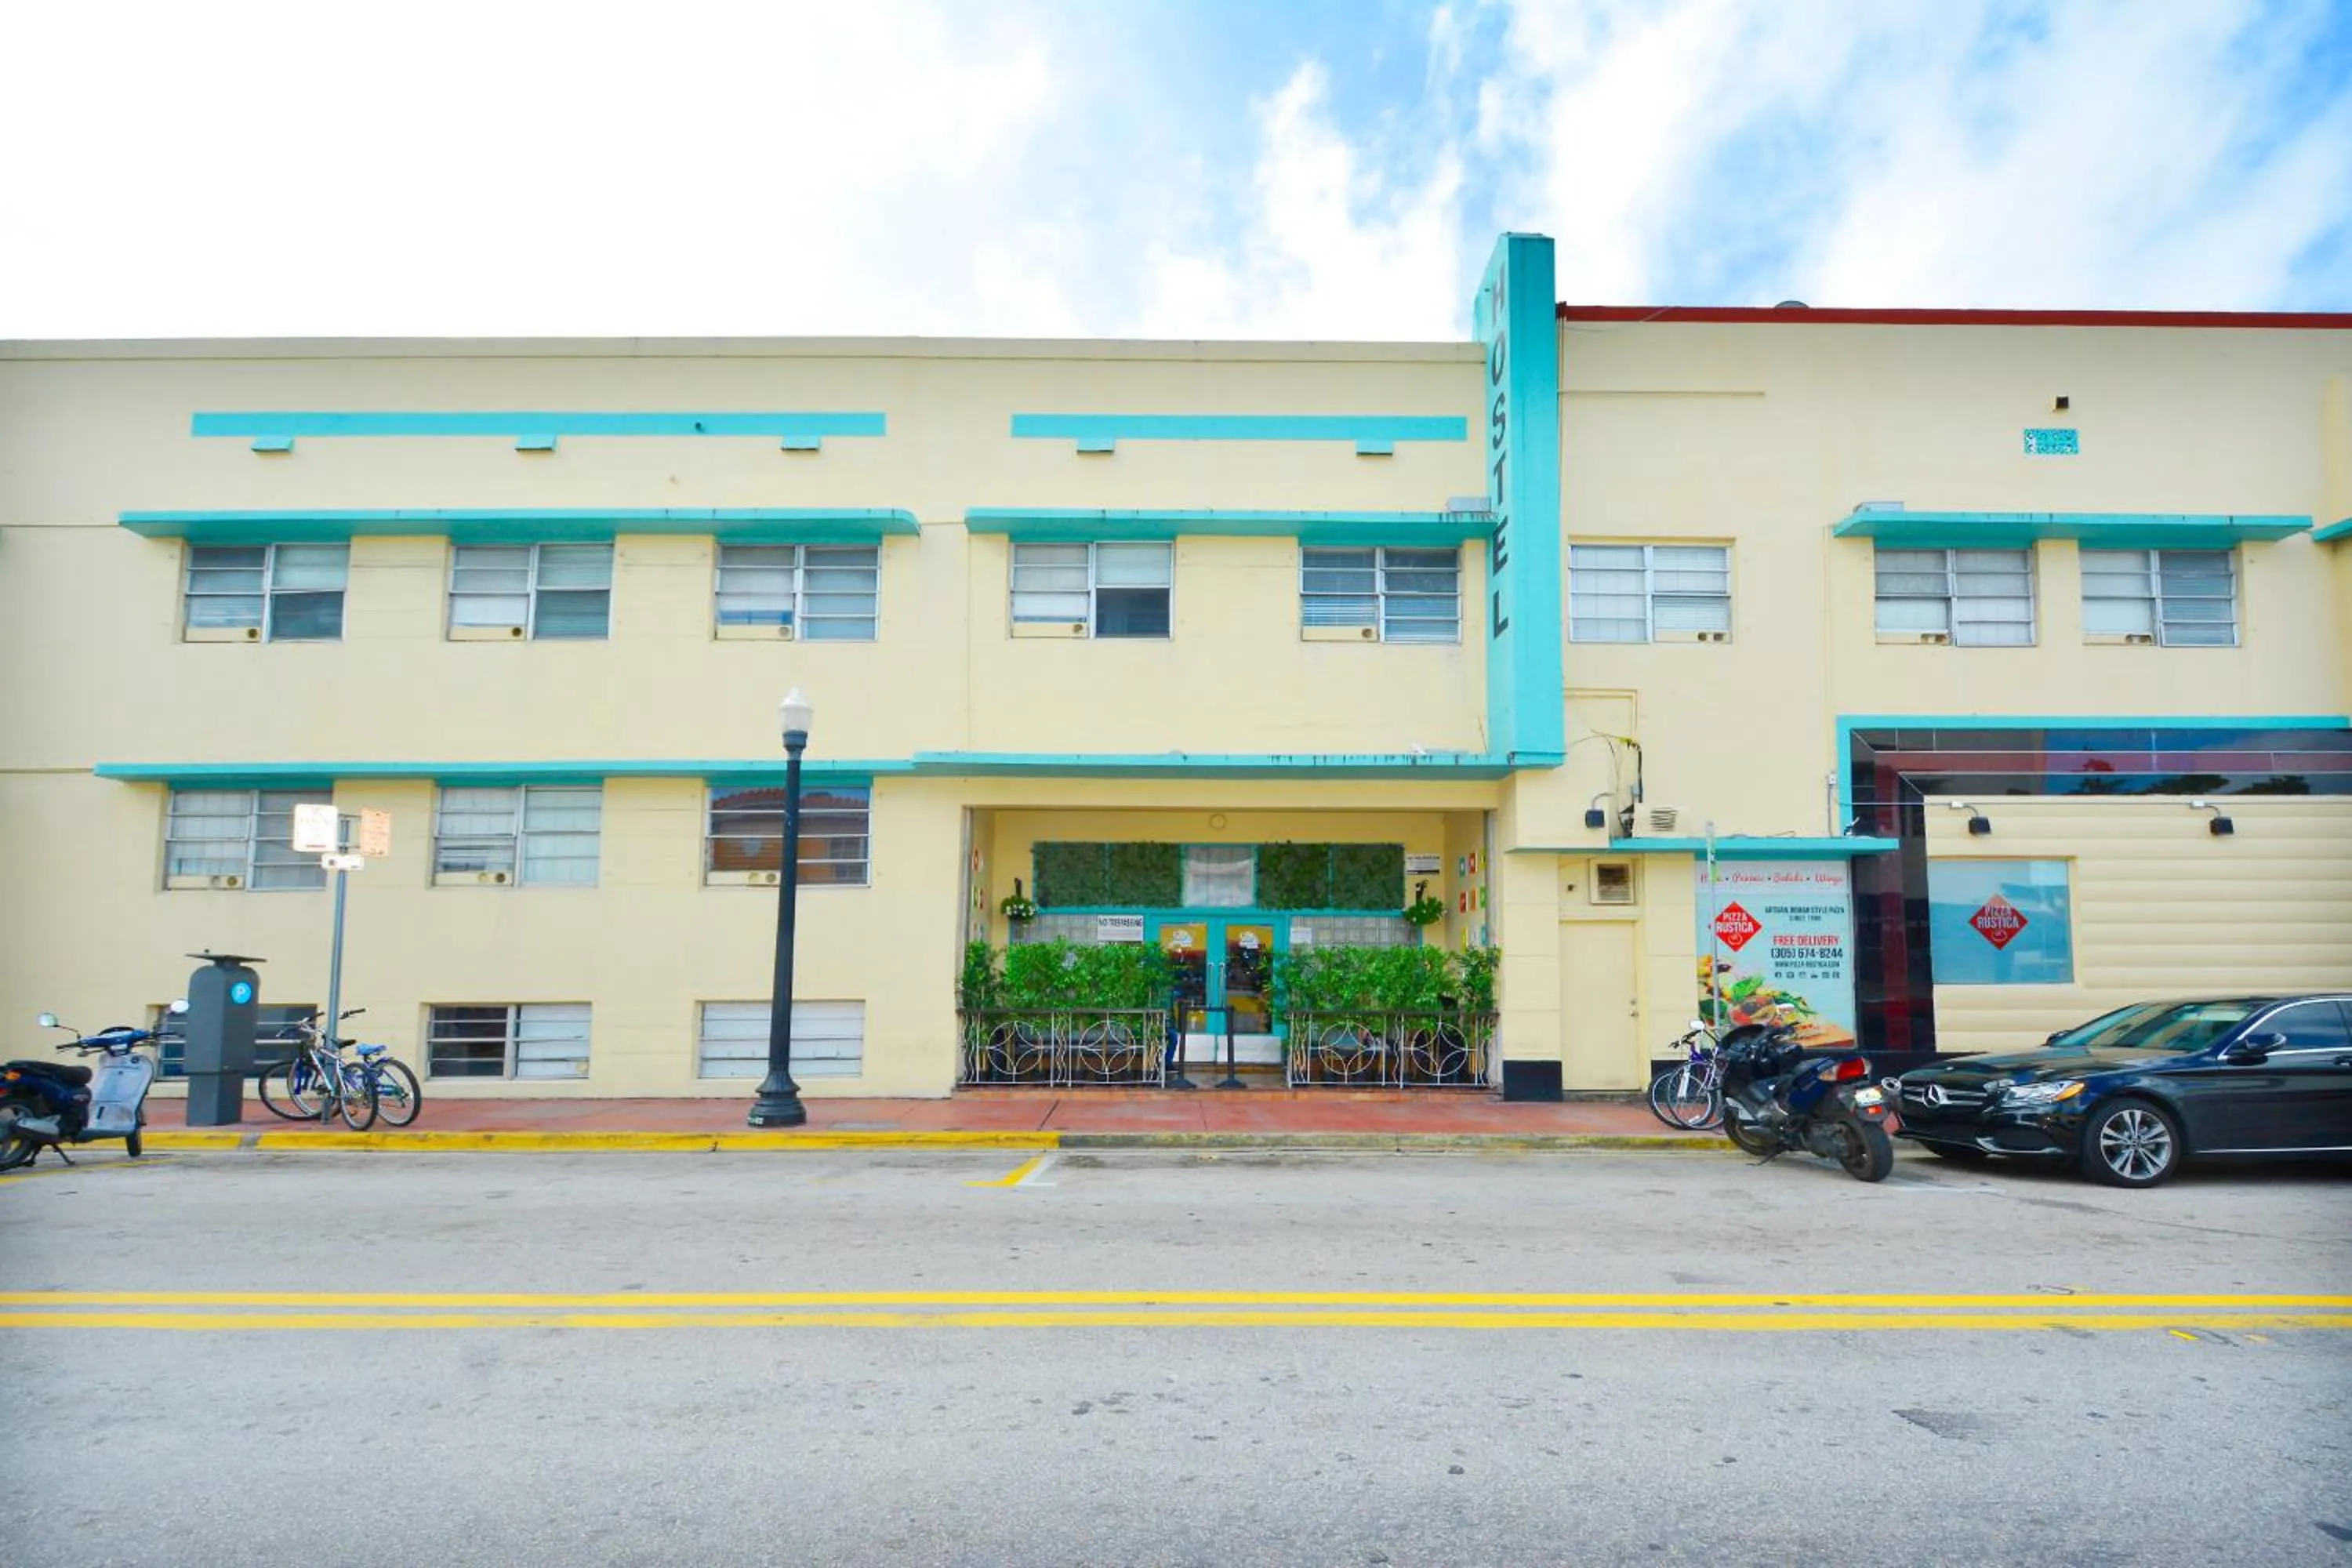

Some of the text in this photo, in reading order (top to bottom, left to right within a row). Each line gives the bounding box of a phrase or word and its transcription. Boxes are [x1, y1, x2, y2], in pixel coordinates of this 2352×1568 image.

[1492, 262, 1509, 640] HOSTEL
[1984, 906, 2012, 916] PIZZA
[1722, 912, 1748, 921] PIZZA
[1098, 918, 1108, 927] NO
[1977, 916, 2020, 928] RUSTICA
[1716, 922, 1754, 933] RUSTICA
[1773, 935, 1839, 946] FREE DELIVERY
[1771, 948, 1843, 958] (305) 674-8244
